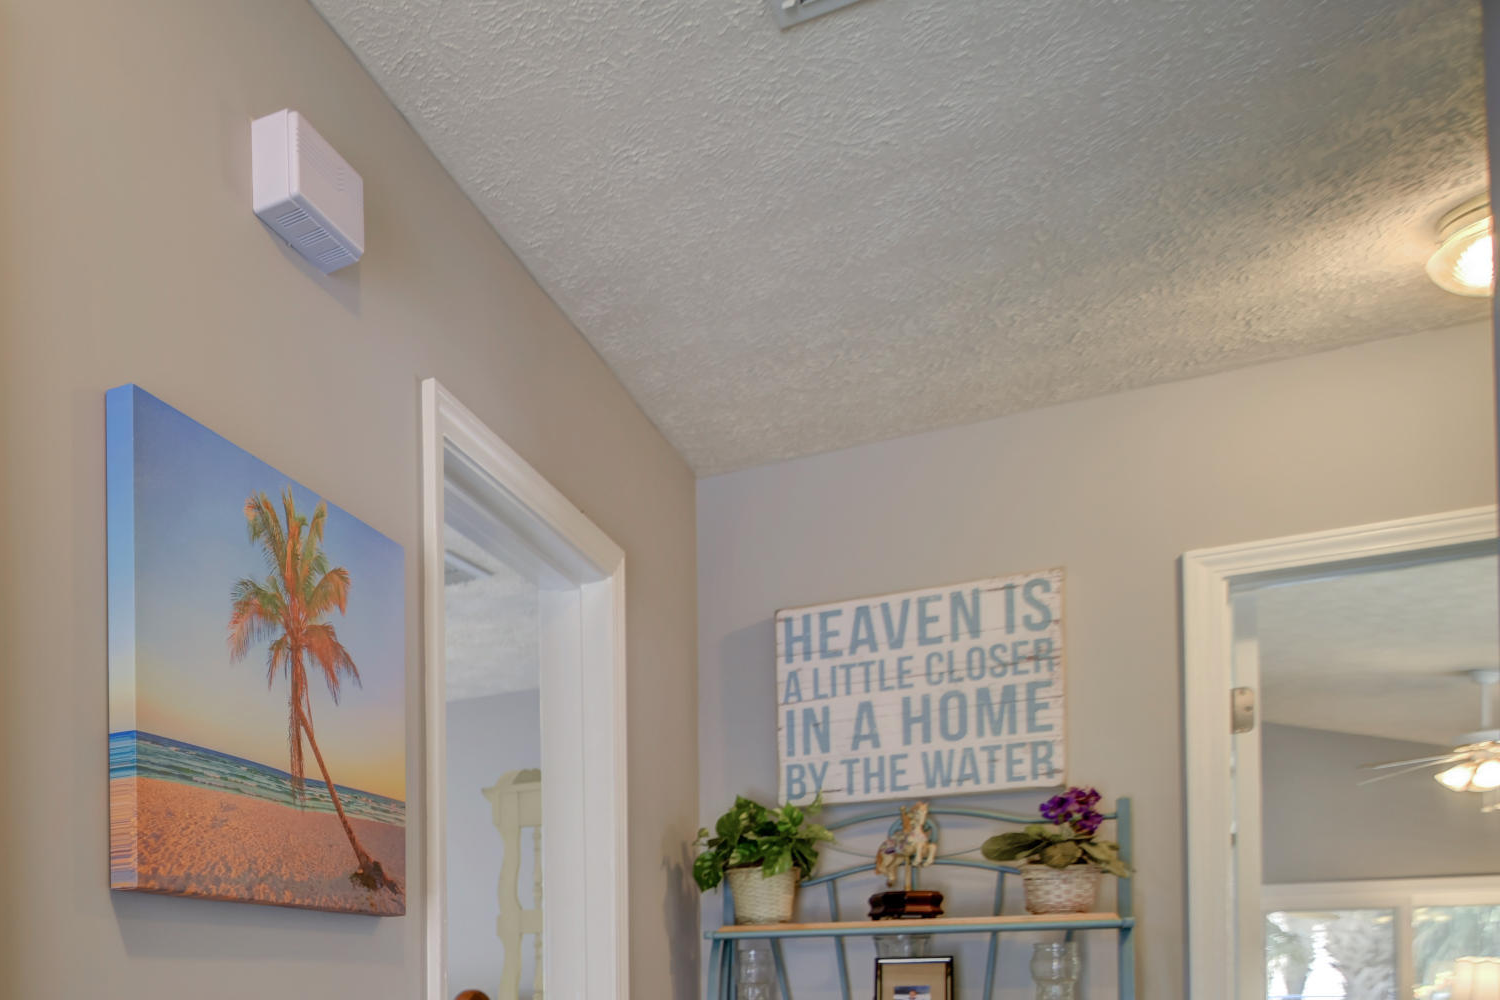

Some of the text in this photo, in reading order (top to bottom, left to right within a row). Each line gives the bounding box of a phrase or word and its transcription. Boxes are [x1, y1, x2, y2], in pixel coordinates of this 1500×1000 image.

[784, 578, 1052, 664] HEAVEN IS
[784, 637, 1054, 704] A LITTLE CLOSER
[786, 680, 1053, 757] IN A HOME
[786, 740, 1055, 800] BY THE WATER
